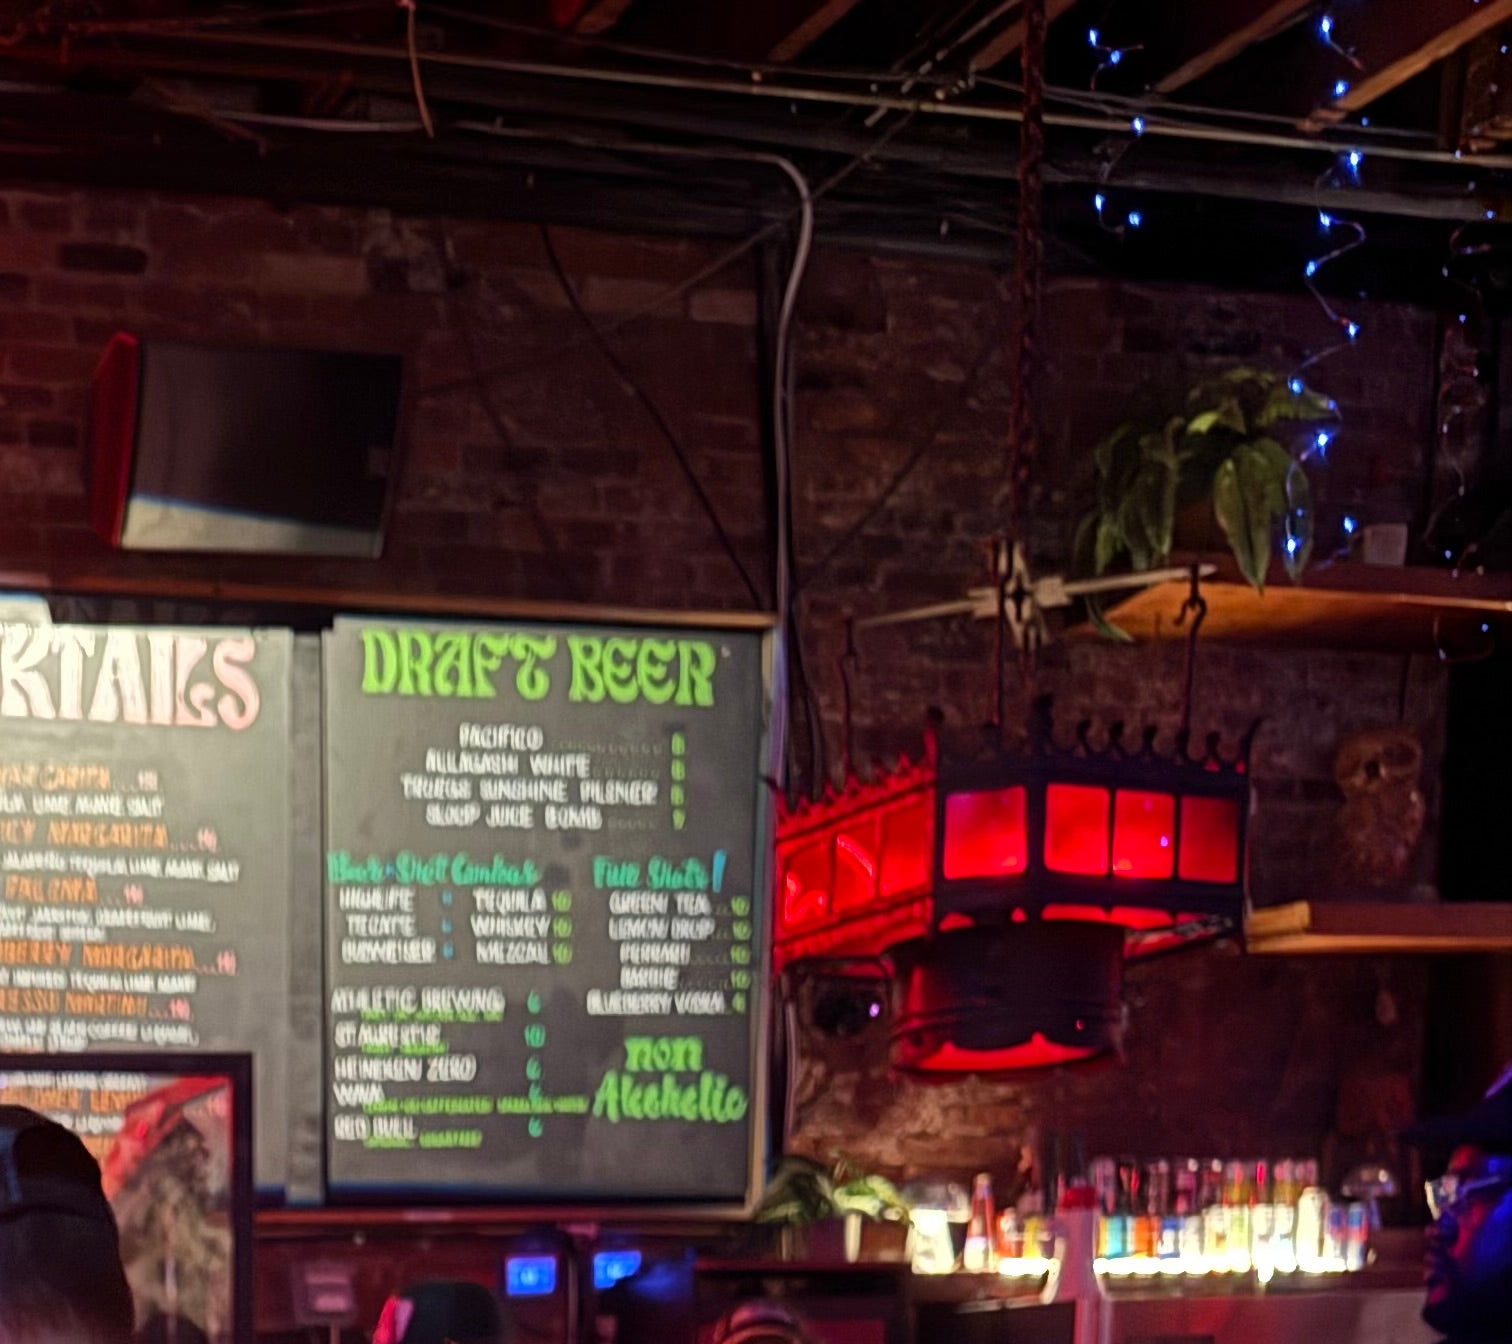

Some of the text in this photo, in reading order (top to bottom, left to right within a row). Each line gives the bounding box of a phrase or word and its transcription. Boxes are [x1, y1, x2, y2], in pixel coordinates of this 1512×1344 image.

[361, 628, 716, 707] DRAFT BEER
[530, 752, 590, 778] WHITE
[579, 779, 659, 806] PILSNER
[47, 819, 168, 849] MARGARITA
[472, 885, 548, 914] TEQUILA
[345, 912, 416, 938] TECATE
[470, 912, 551, 939] WHISKEY
[82, 943, 194, 971] MARGARITA
[331, 984, 418, 1016] ATHLETIC
[624, 1034, 704, 1072] non
[426, 1054, 478, 1083] ZERO
[592, 1070, 748, 1124] Alcoholic
